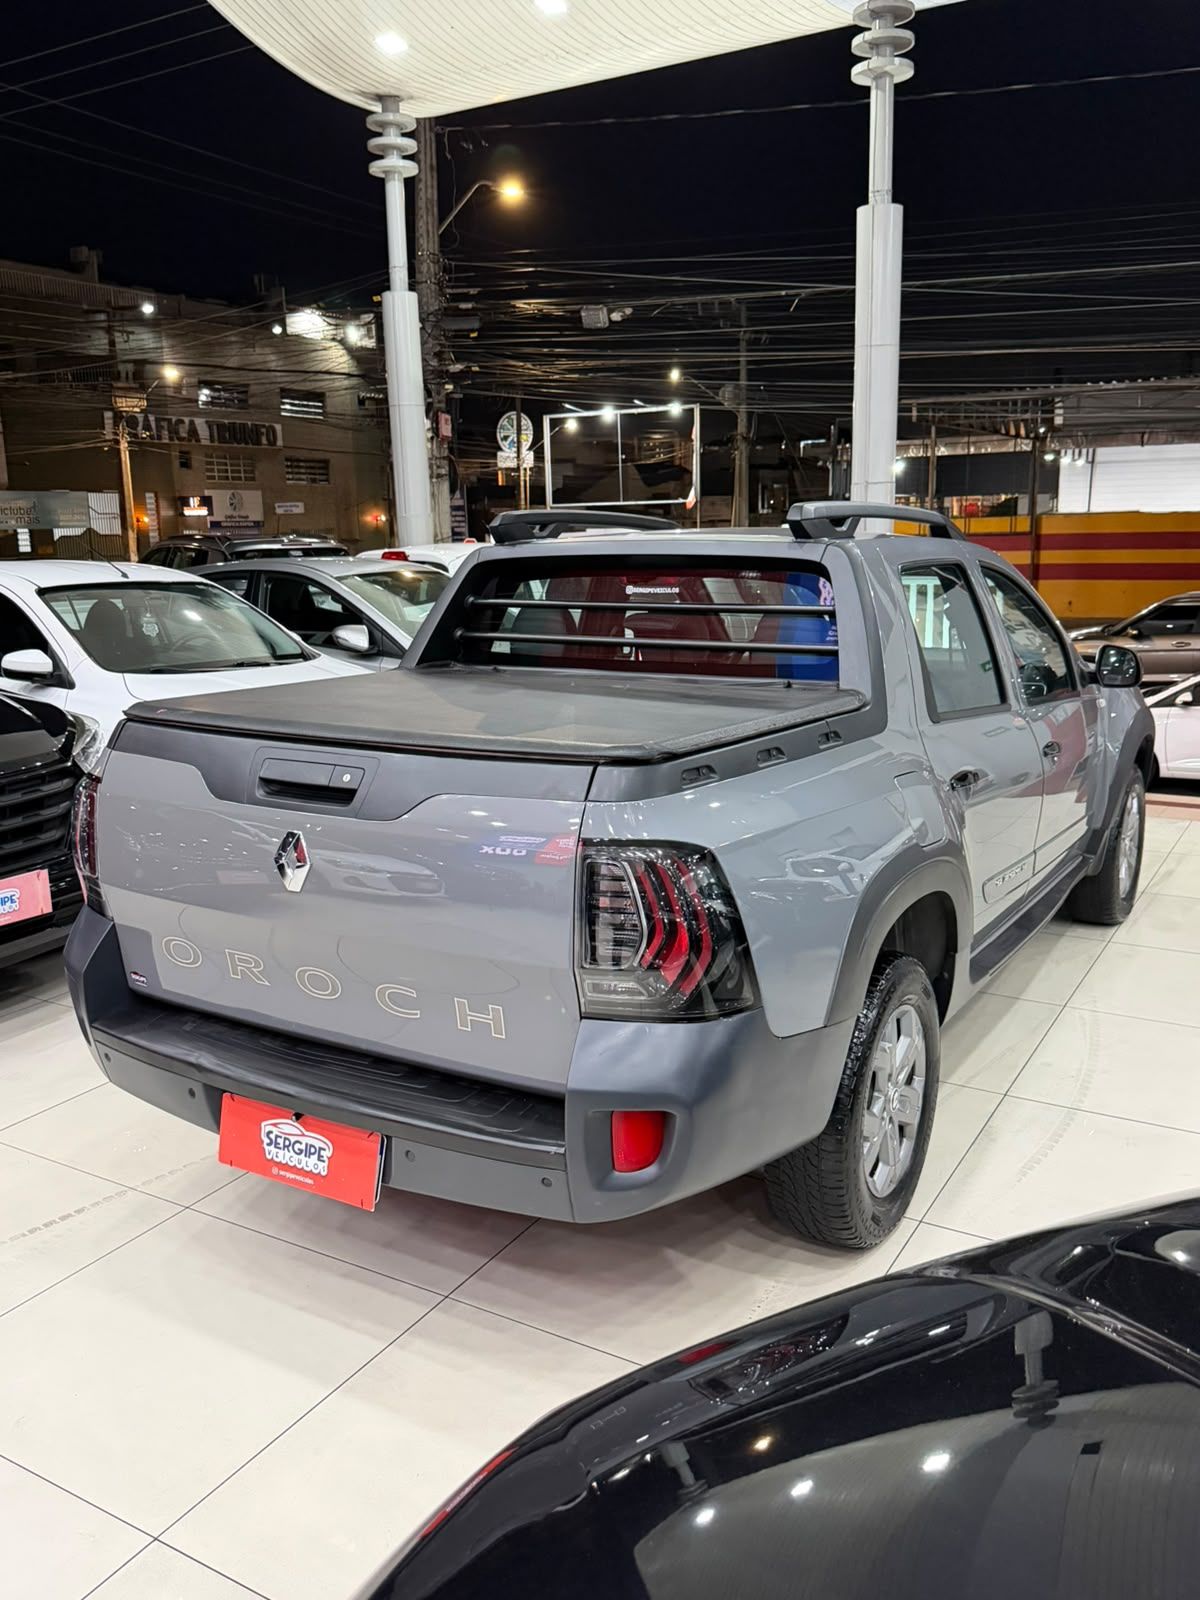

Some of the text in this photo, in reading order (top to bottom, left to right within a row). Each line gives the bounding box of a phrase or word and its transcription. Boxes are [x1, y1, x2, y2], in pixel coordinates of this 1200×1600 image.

[205, 420, 278, 446] TRIUNFO
[162, 936, 506, 1039] OROCH
[265, 1130, 327, 1163] SERGIPE
